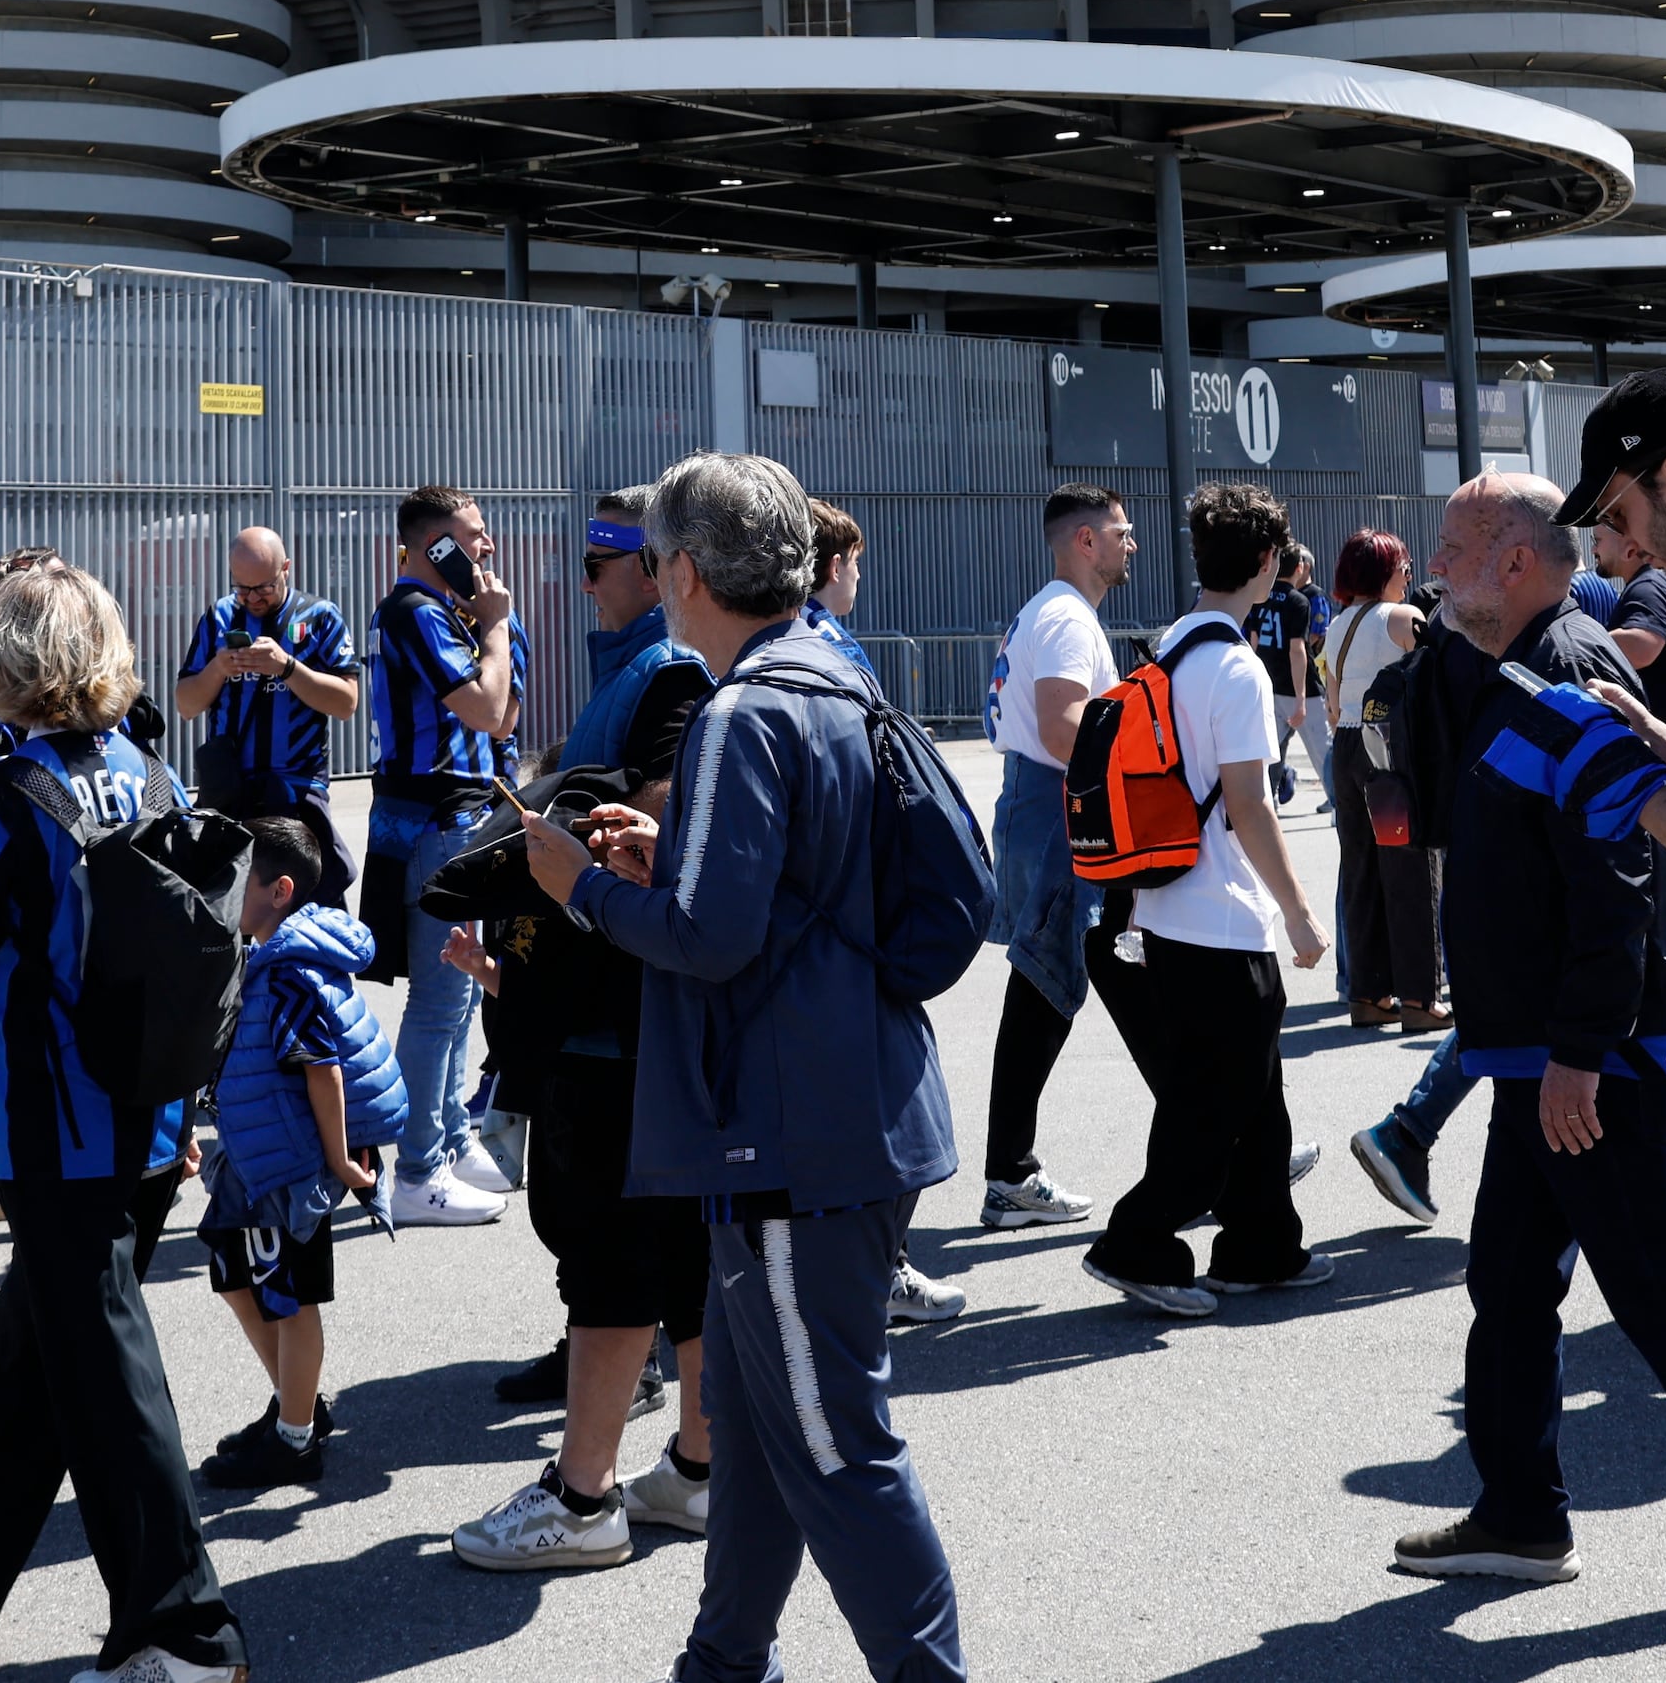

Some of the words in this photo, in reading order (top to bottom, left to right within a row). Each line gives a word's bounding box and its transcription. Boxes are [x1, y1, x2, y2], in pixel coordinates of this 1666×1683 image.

[1055, 356, 1067, 382] 10
[1150, 368, 1232, 413] INESSO
[1242, 380, 1271, 451] 11
